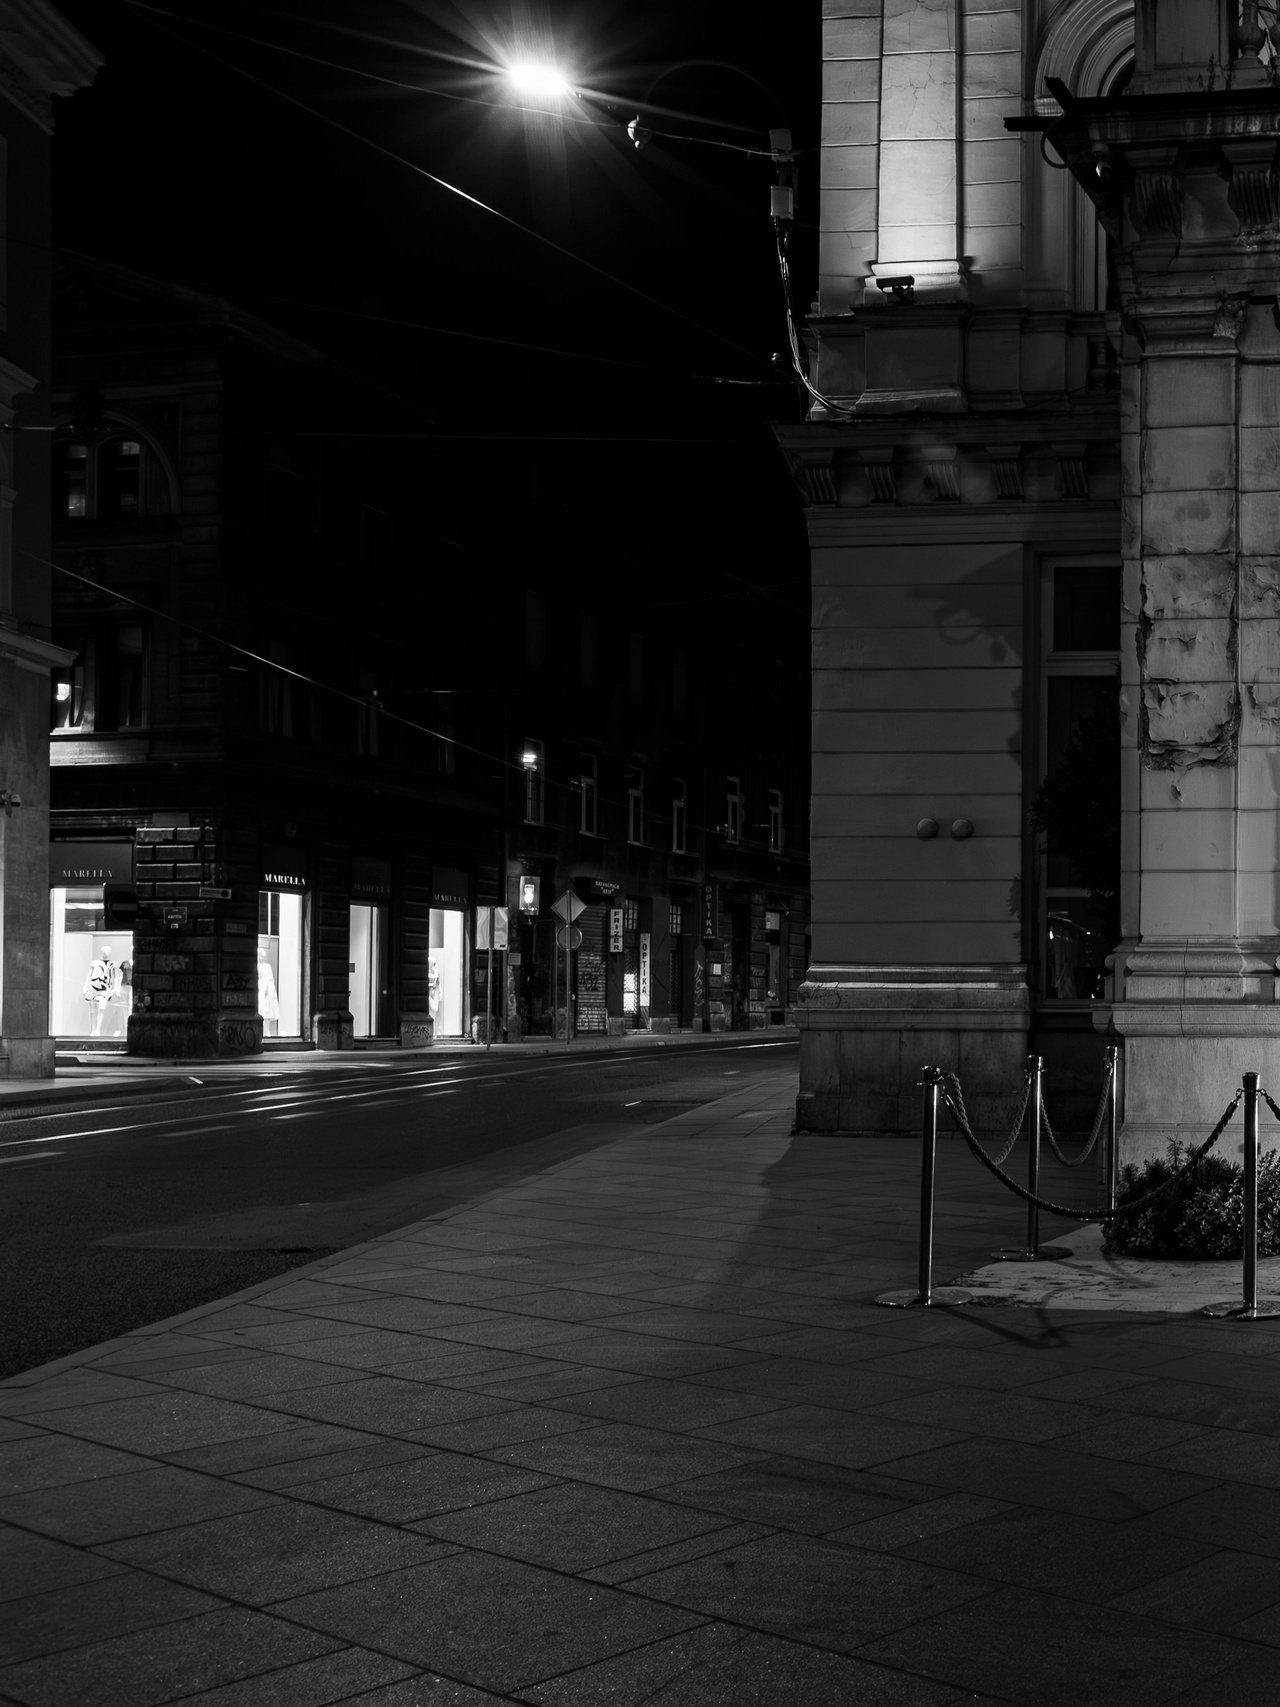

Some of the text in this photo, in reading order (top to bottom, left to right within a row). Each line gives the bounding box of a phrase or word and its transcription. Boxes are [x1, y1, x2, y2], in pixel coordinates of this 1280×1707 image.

[62, 868, 114, 879] MARELLA
[264, 873, 306, 886] MARELLA
[354, 883, 390, 895] MARELLA
[704, 885, 713, 936] OPTIKA
